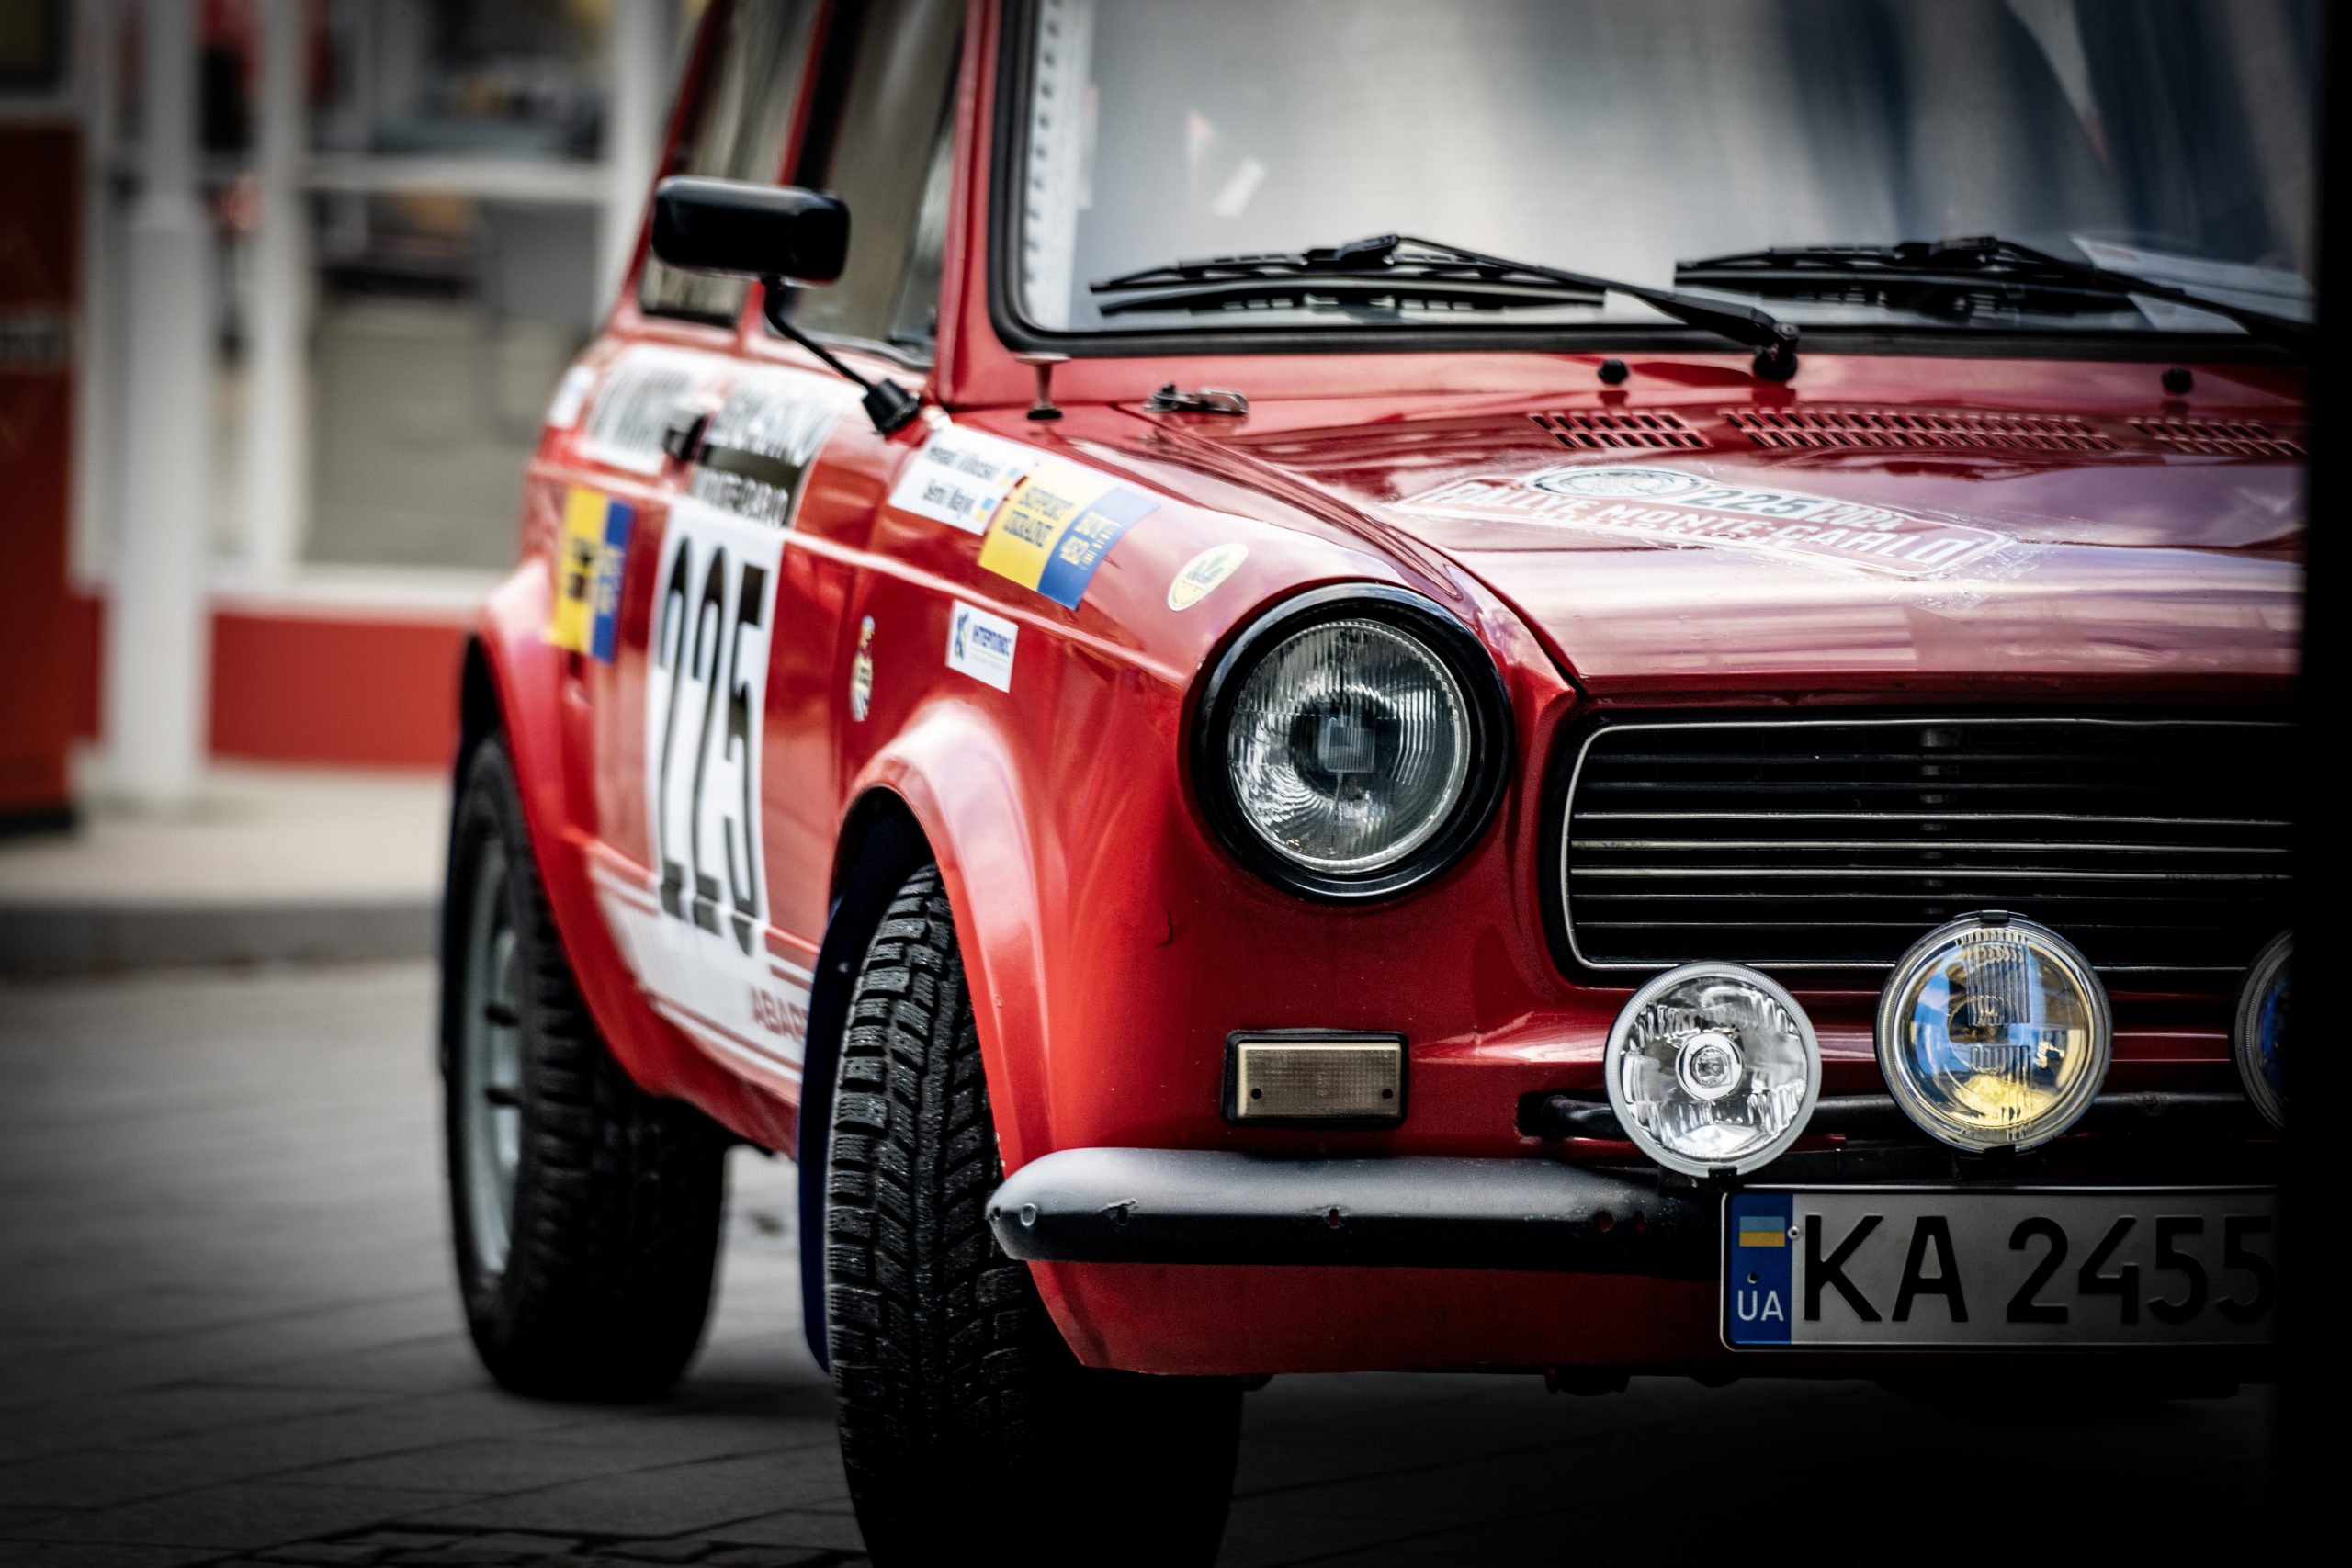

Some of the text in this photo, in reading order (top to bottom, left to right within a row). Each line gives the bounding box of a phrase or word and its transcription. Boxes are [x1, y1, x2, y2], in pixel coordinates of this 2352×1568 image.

[1681, 490, 1825, 515] 225
[657, 534, 769, 957] 225
[1804, 1213, 2278, 1325] KA 2455
[1737, 1290, 1784, 1323] UA
